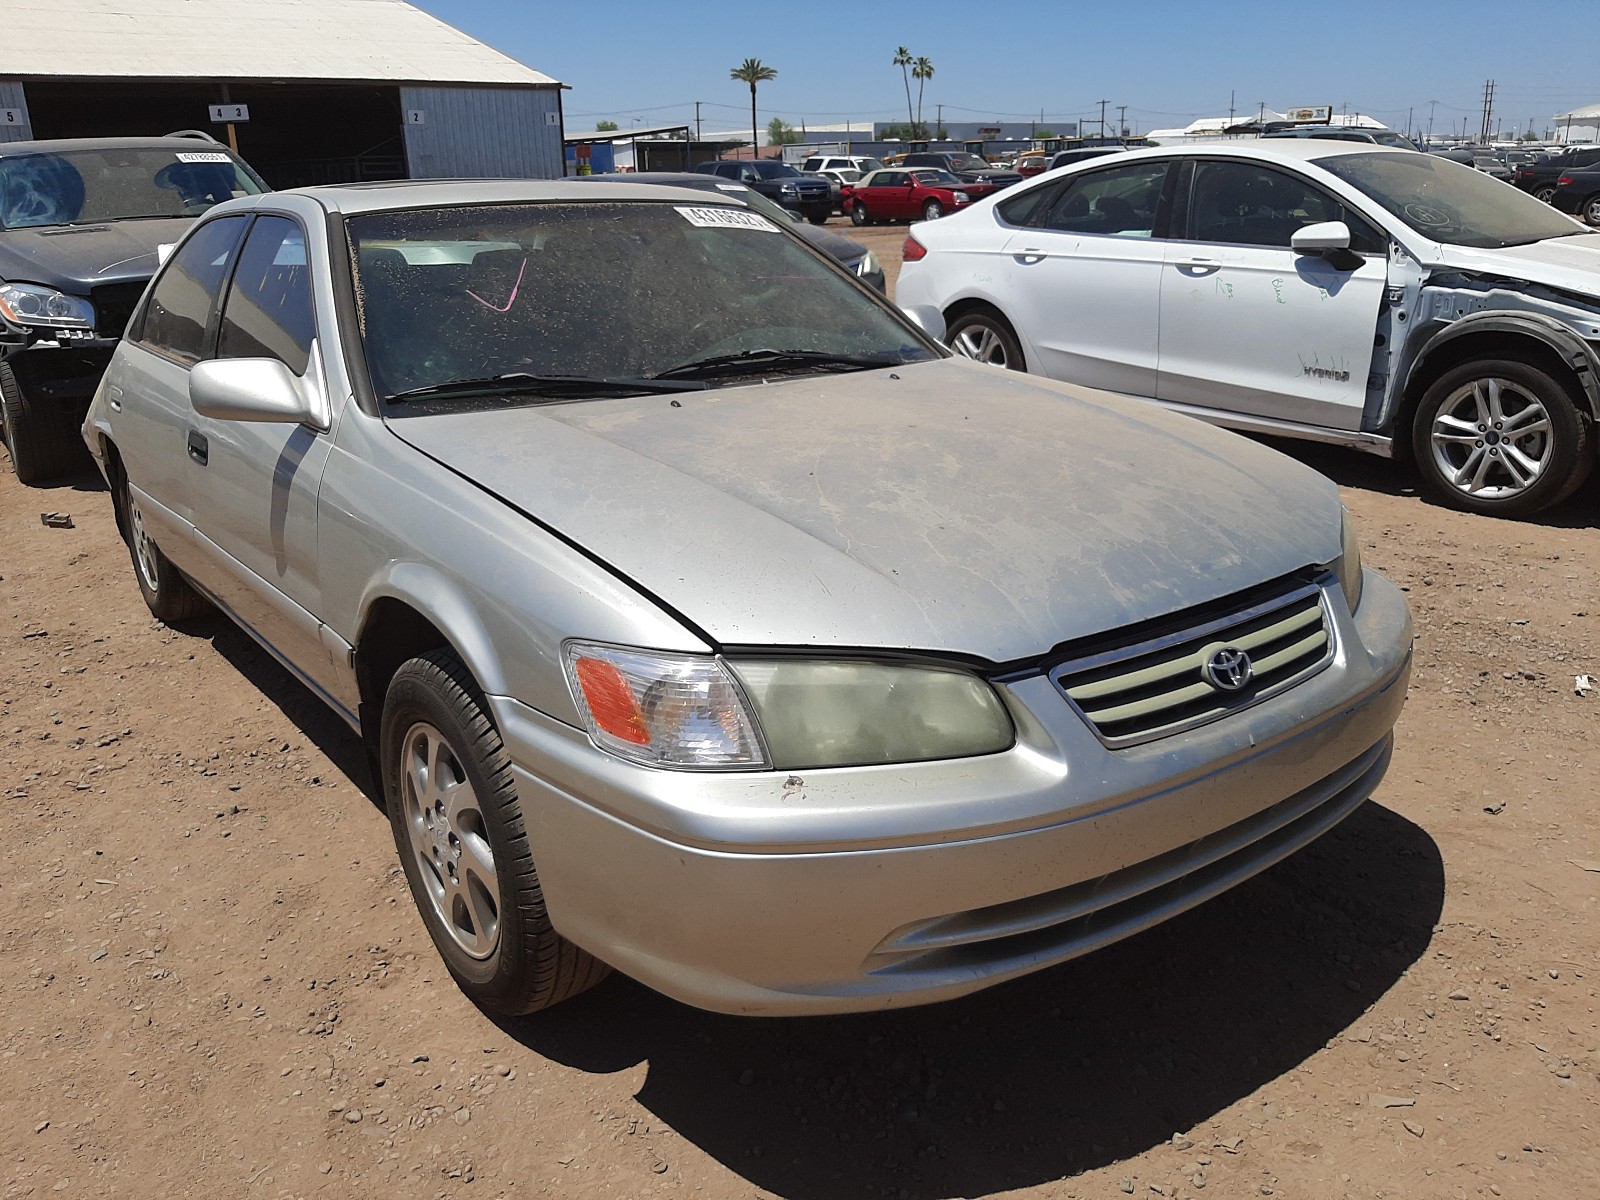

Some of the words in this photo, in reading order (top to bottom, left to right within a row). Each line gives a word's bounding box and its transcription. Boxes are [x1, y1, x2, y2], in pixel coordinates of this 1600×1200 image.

[6, 111, 14, 122] 5
[217, 108, 223, 118] 4
[235, 107, 242, 117] 3
[413, 112, 419, 122] 2
